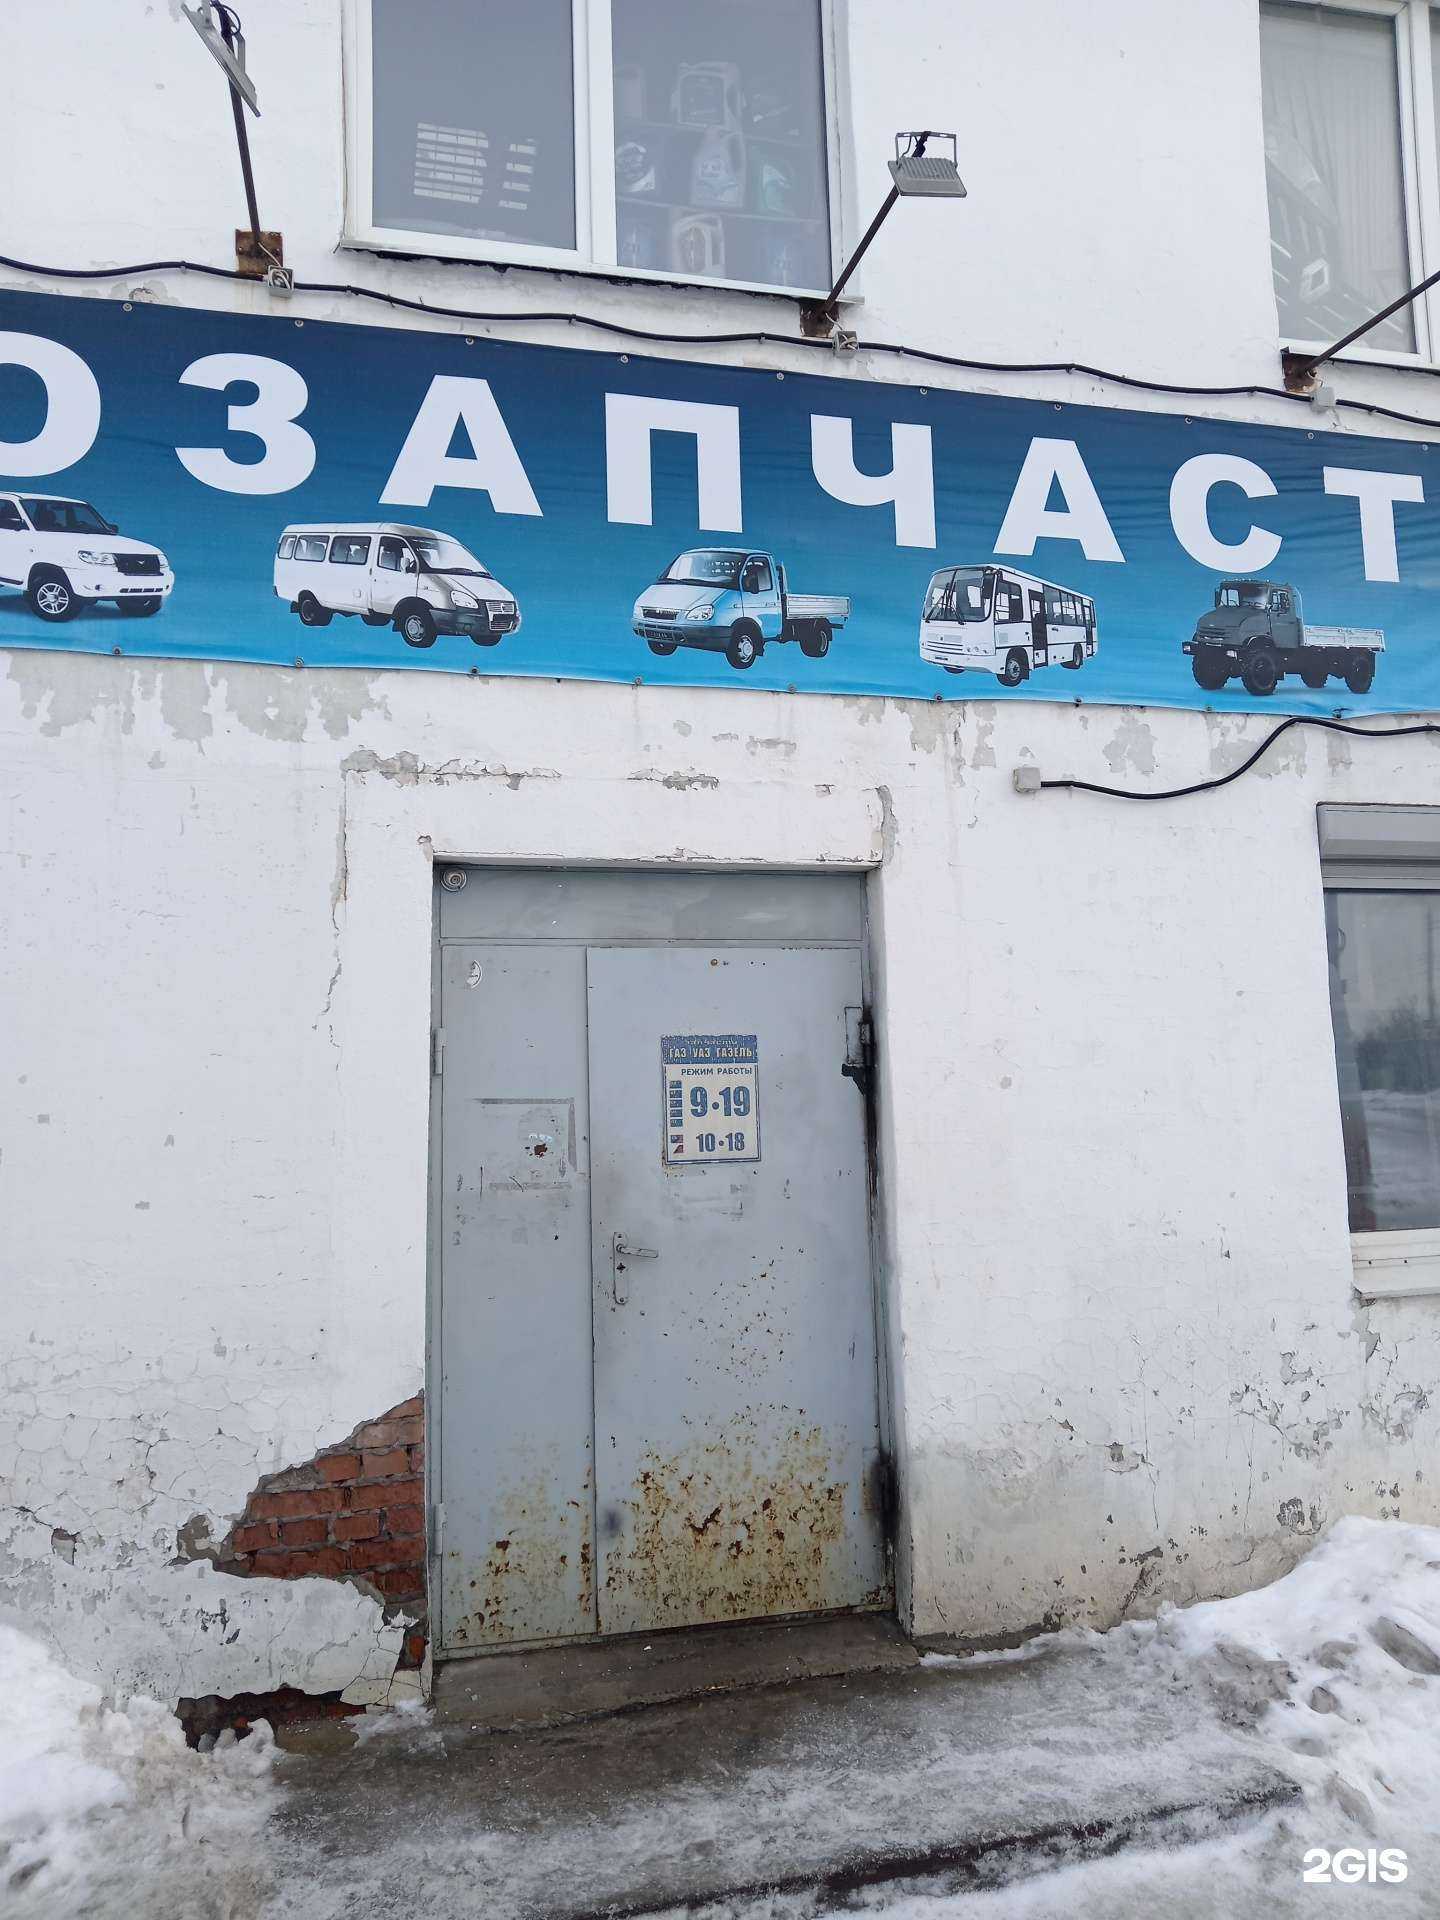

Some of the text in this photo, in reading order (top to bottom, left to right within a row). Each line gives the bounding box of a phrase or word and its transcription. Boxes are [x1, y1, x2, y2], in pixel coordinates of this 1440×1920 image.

[669, 1047, 752, 1058] ГАЗ УАЗ ГАЗЕЛЬ
[681, 1067, 752, 1076] РЕЖИМ РАБОТЫ
